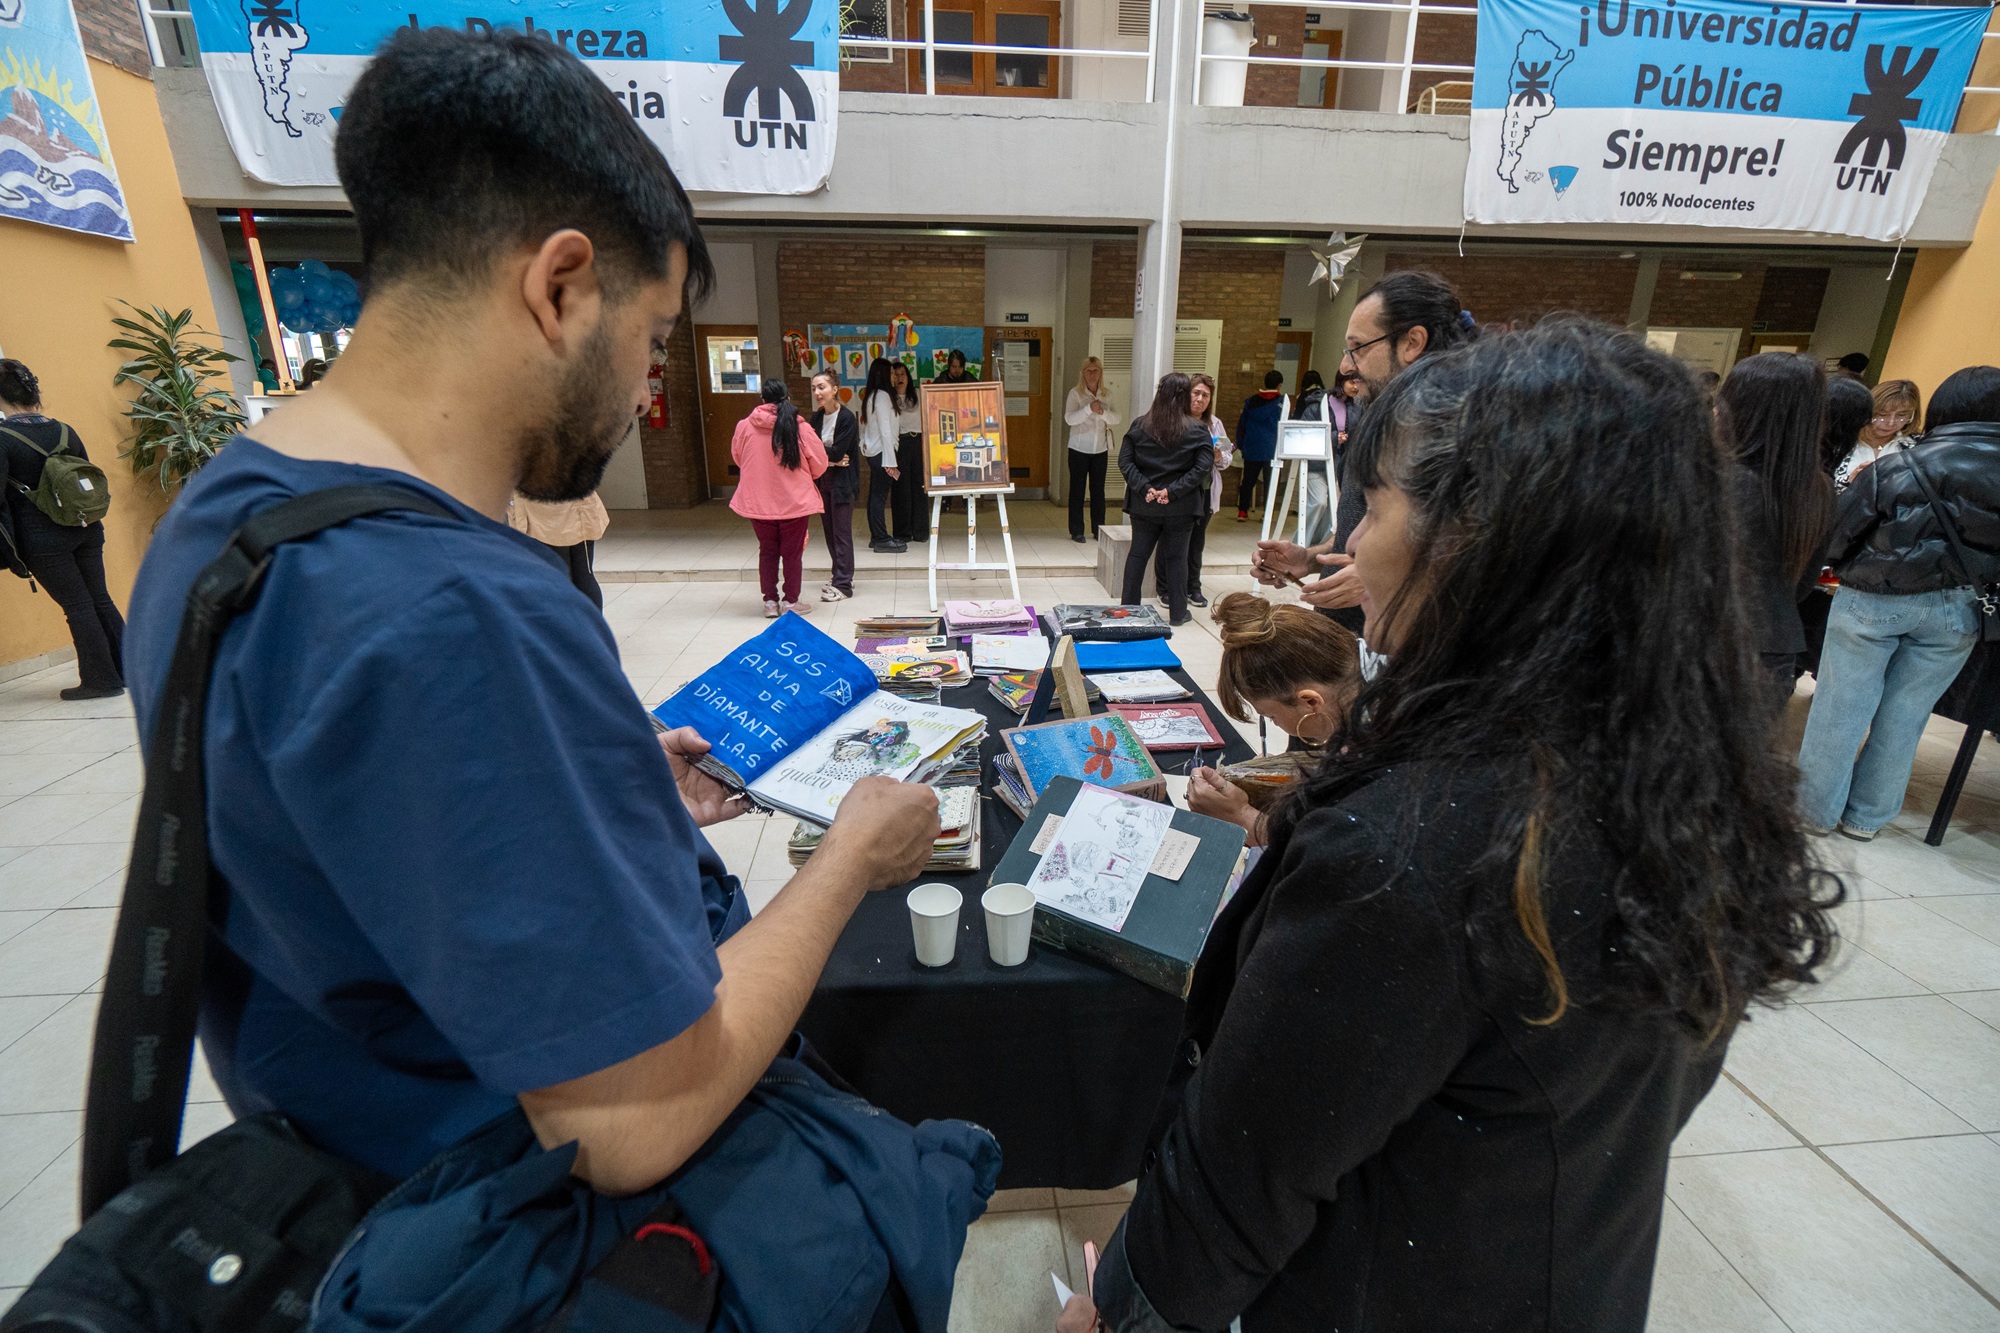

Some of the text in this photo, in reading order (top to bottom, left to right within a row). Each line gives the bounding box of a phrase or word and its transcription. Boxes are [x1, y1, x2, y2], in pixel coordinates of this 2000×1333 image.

[1579, 0, 1861, 52] ¡Universidad
[1634, 63, 1783, 112] Pública
[734, 120, 807, 150] UTN
[1602, 128, 1785, 185] Siempre!
[1836, 166, 1893, 196] UTN
[1619, 191, 1755, 212] 100% Nodocentes
[776, 641, 826, 676] SOS
[739, 653, 800, 695] ALMA
[758, 690, 787, 713] DE
[873, 697, 938, 718] estoy en
[909, 718, 963, 732] donde
[776, 766, 832, 790] quiero
